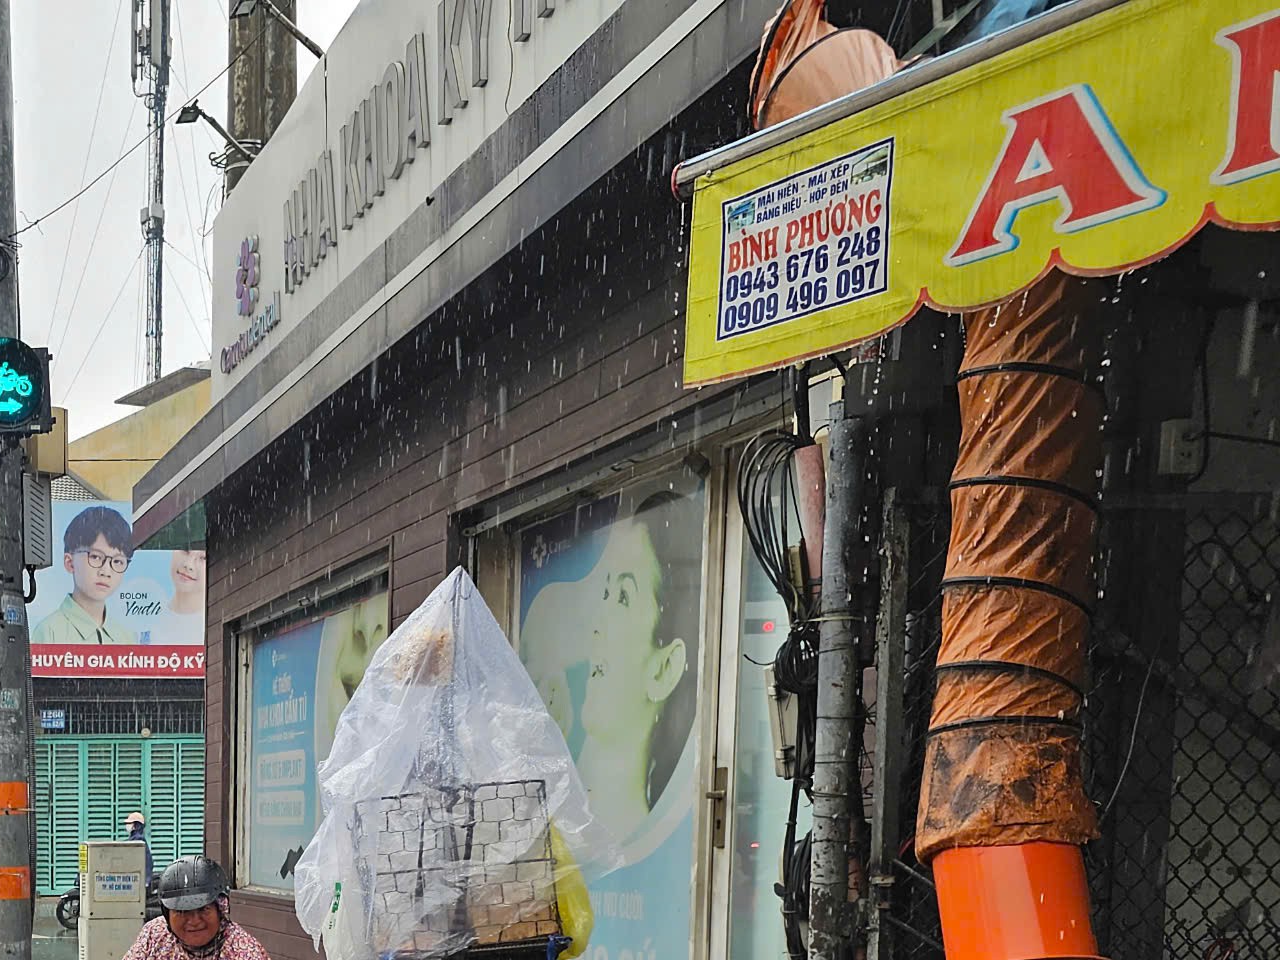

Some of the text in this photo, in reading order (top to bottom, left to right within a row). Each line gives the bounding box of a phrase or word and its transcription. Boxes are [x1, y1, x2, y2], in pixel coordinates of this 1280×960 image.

[284, 149, 337, 294] NHA
[340, 32, 431, 230] KHOA
[757, 193, 775, 209] MÁI
[808, 171, 828, 189] MÁI
[830, 163, 849, 180] XẾP
[830, 179, 849, 196] ĐÈN
[728, 189, 882, 274] BÌNH PHƯƠNG
[726, 225, 881, 303] 0943 676 248
[724, 258, 880, 332] 0909 496 097
[120, 592, 148, 600] BOLON
[125, 600, 162, 617] Youth
[87, 656, 115, 668] GIA
[118, 652, 155, 668] KÍNH
[157, 653, 181, 672] ĐỘ
[184, 652, 205, 668] KỸ
